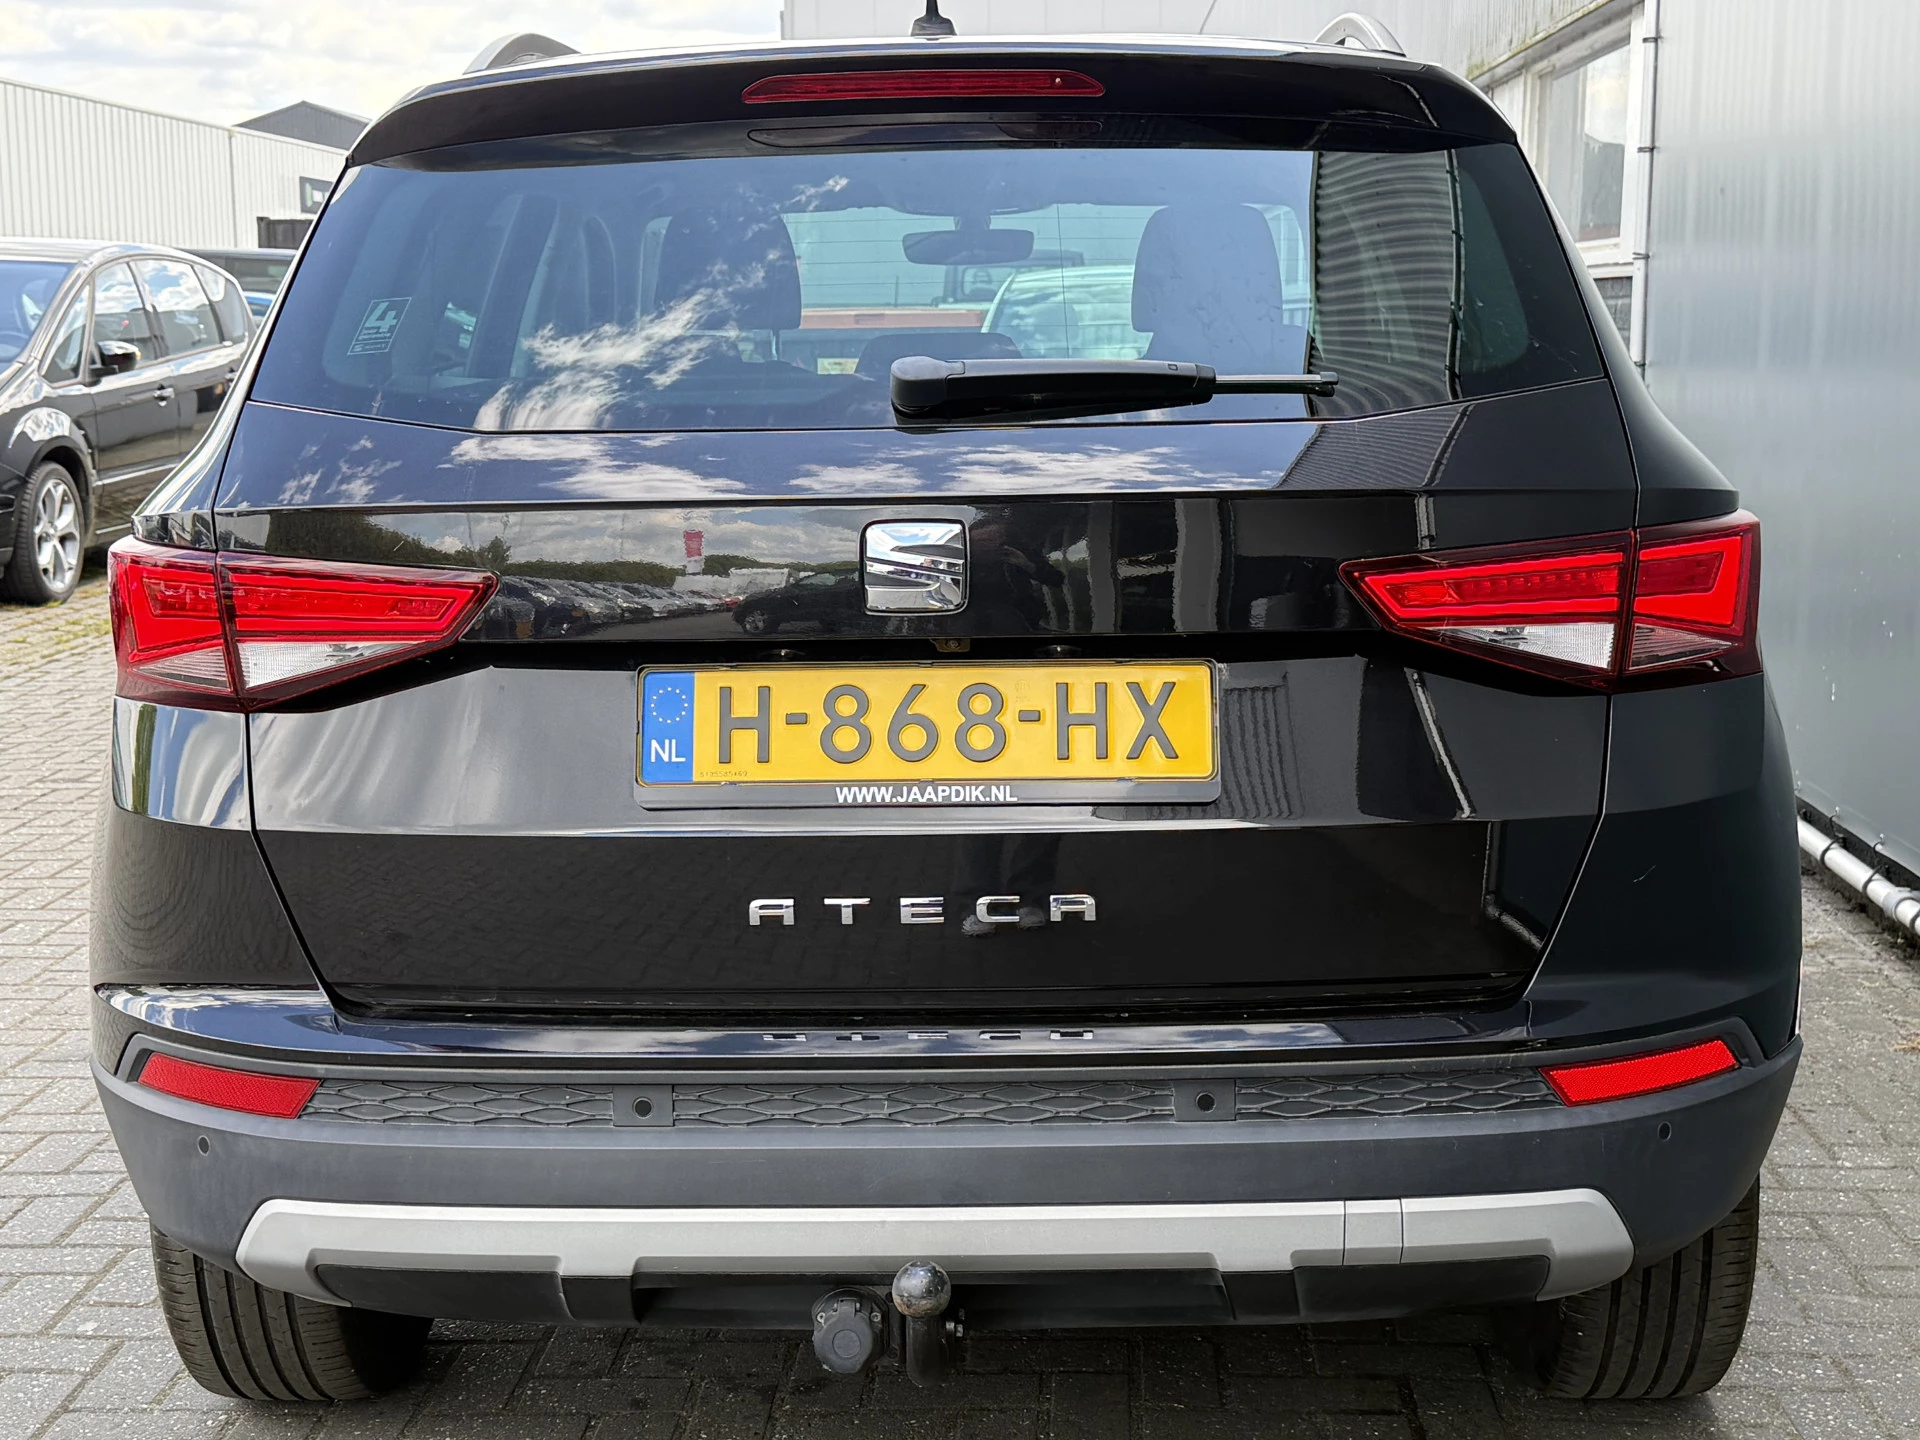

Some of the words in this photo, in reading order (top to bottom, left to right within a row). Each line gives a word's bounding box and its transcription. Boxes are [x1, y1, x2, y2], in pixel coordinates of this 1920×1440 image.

[364, 301, 398, 333] 4
[718, 681, 1179, 764] H-868-HX
[650, 738, 687, 763] NL
[835, 785, 1018, 804] WWW.JAAPDIK.NL
[748, 894, 1097, 926] ATECA
